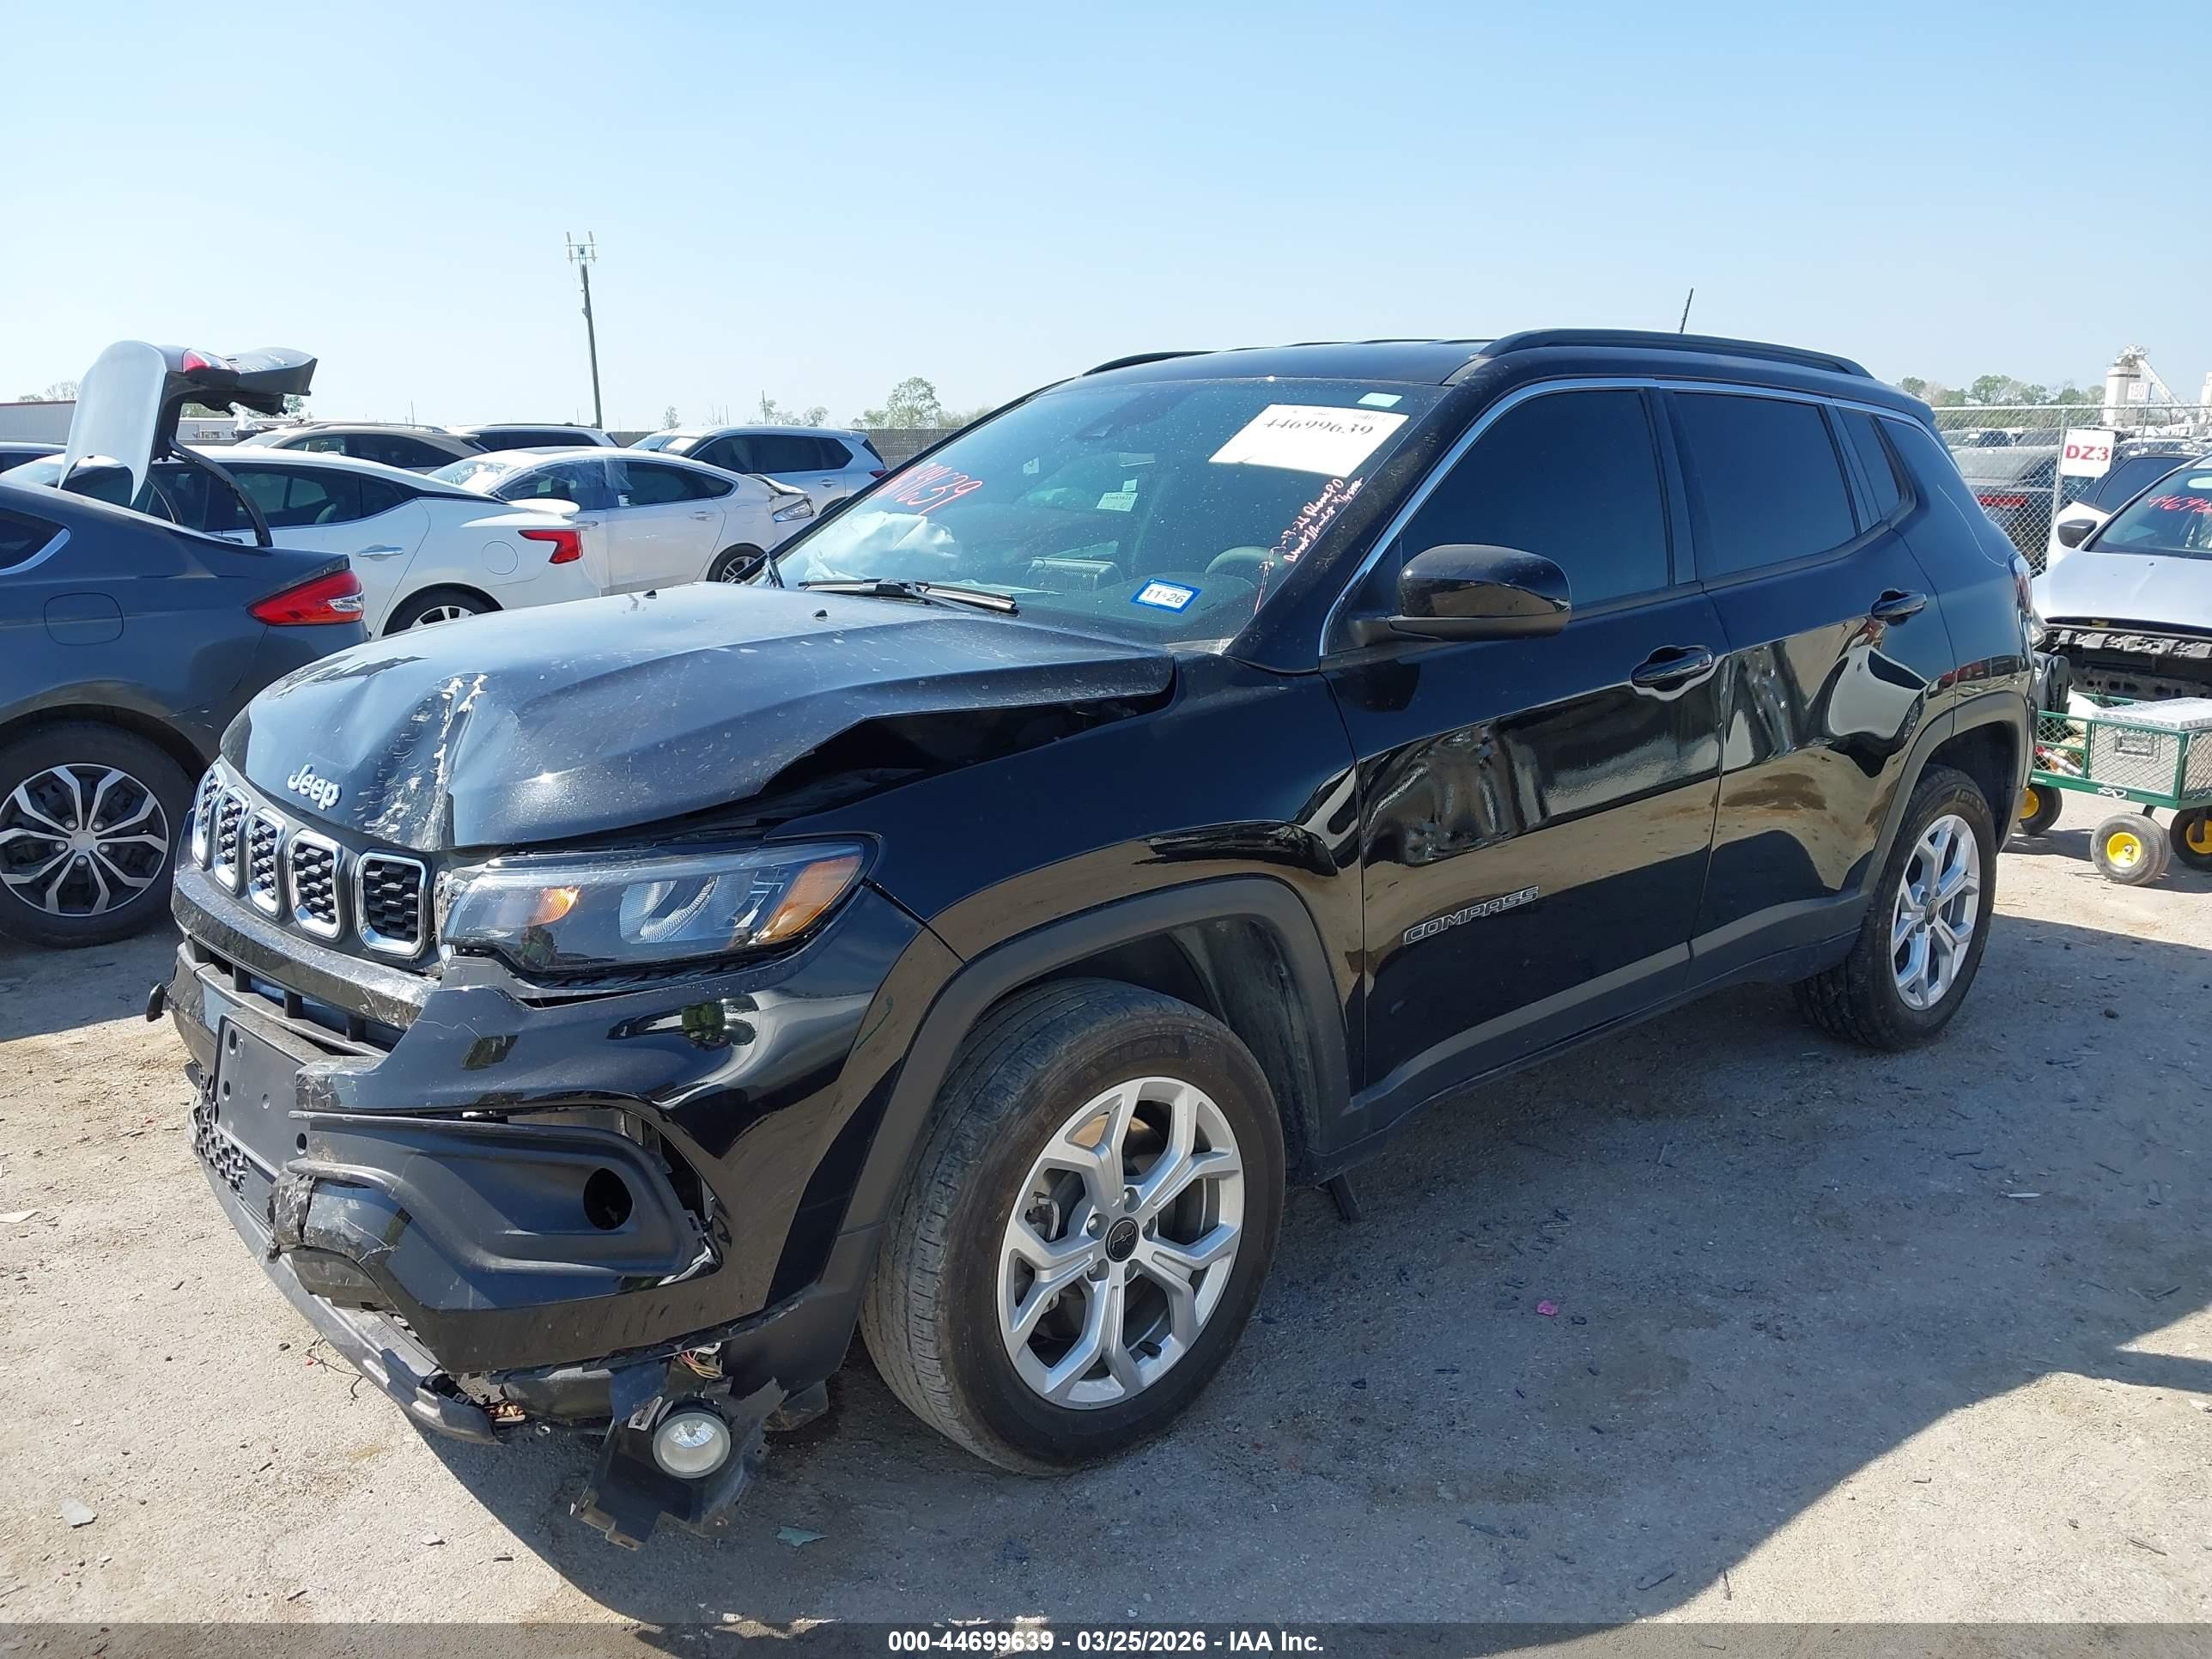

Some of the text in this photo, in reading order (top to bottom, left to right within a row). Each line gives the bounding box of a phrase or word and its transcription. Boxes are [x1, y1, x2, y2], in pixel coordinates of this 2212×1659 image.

[2130, 386, 2145, 398] 150
[1264, 418, 1374, 435] 44699639
[2065, 444, 2110, 461] DZ3
[287, 763, 342, 811] Jeep
[1403, 885, 1539, 945] COMPASS
